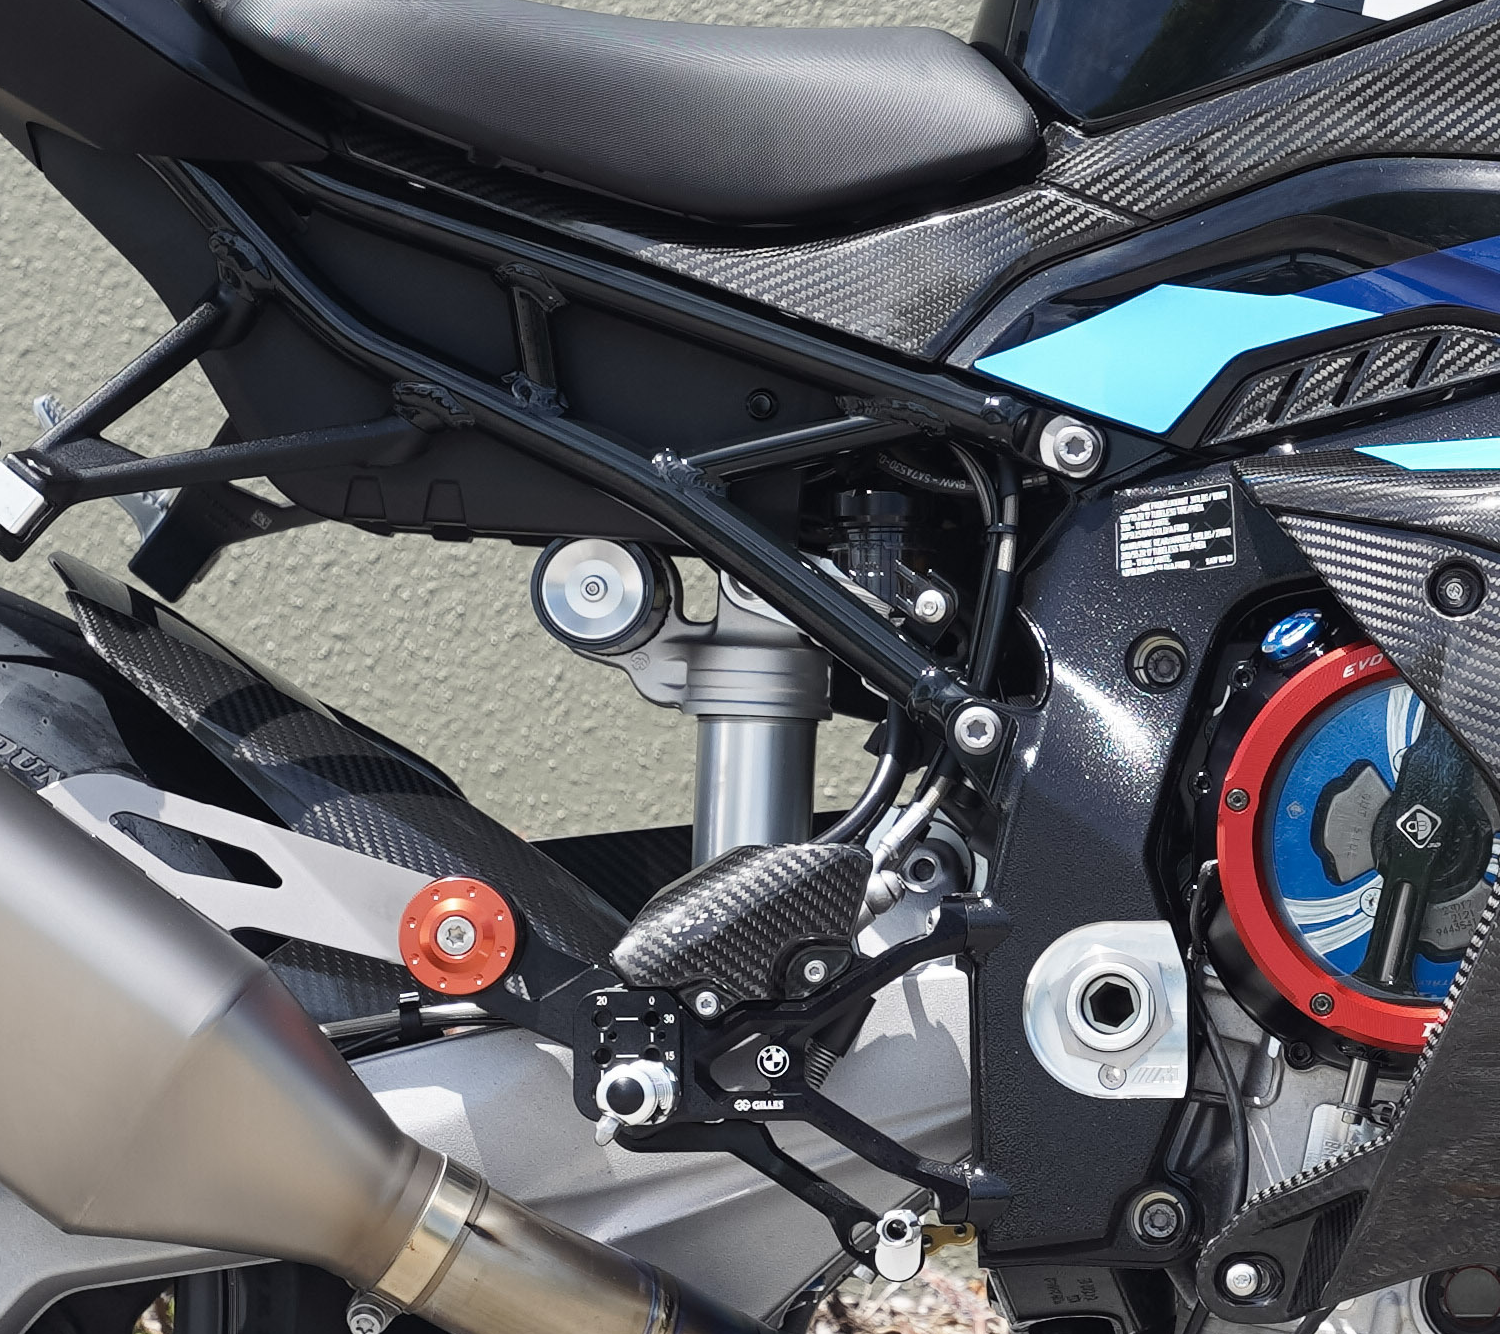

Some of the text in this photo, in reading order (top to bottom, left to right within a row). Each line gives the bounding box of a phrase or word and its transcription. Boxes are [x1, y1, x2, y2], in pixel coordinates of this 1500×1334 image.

[1342, 653, 1384, 679] EVO
[596, 995, 656, 1006] 20 0
[663, 1013, 676, 1024] 30
[664, 1050, 676, 1061] 15
[751, 1099, 785, 1110] GILLES
